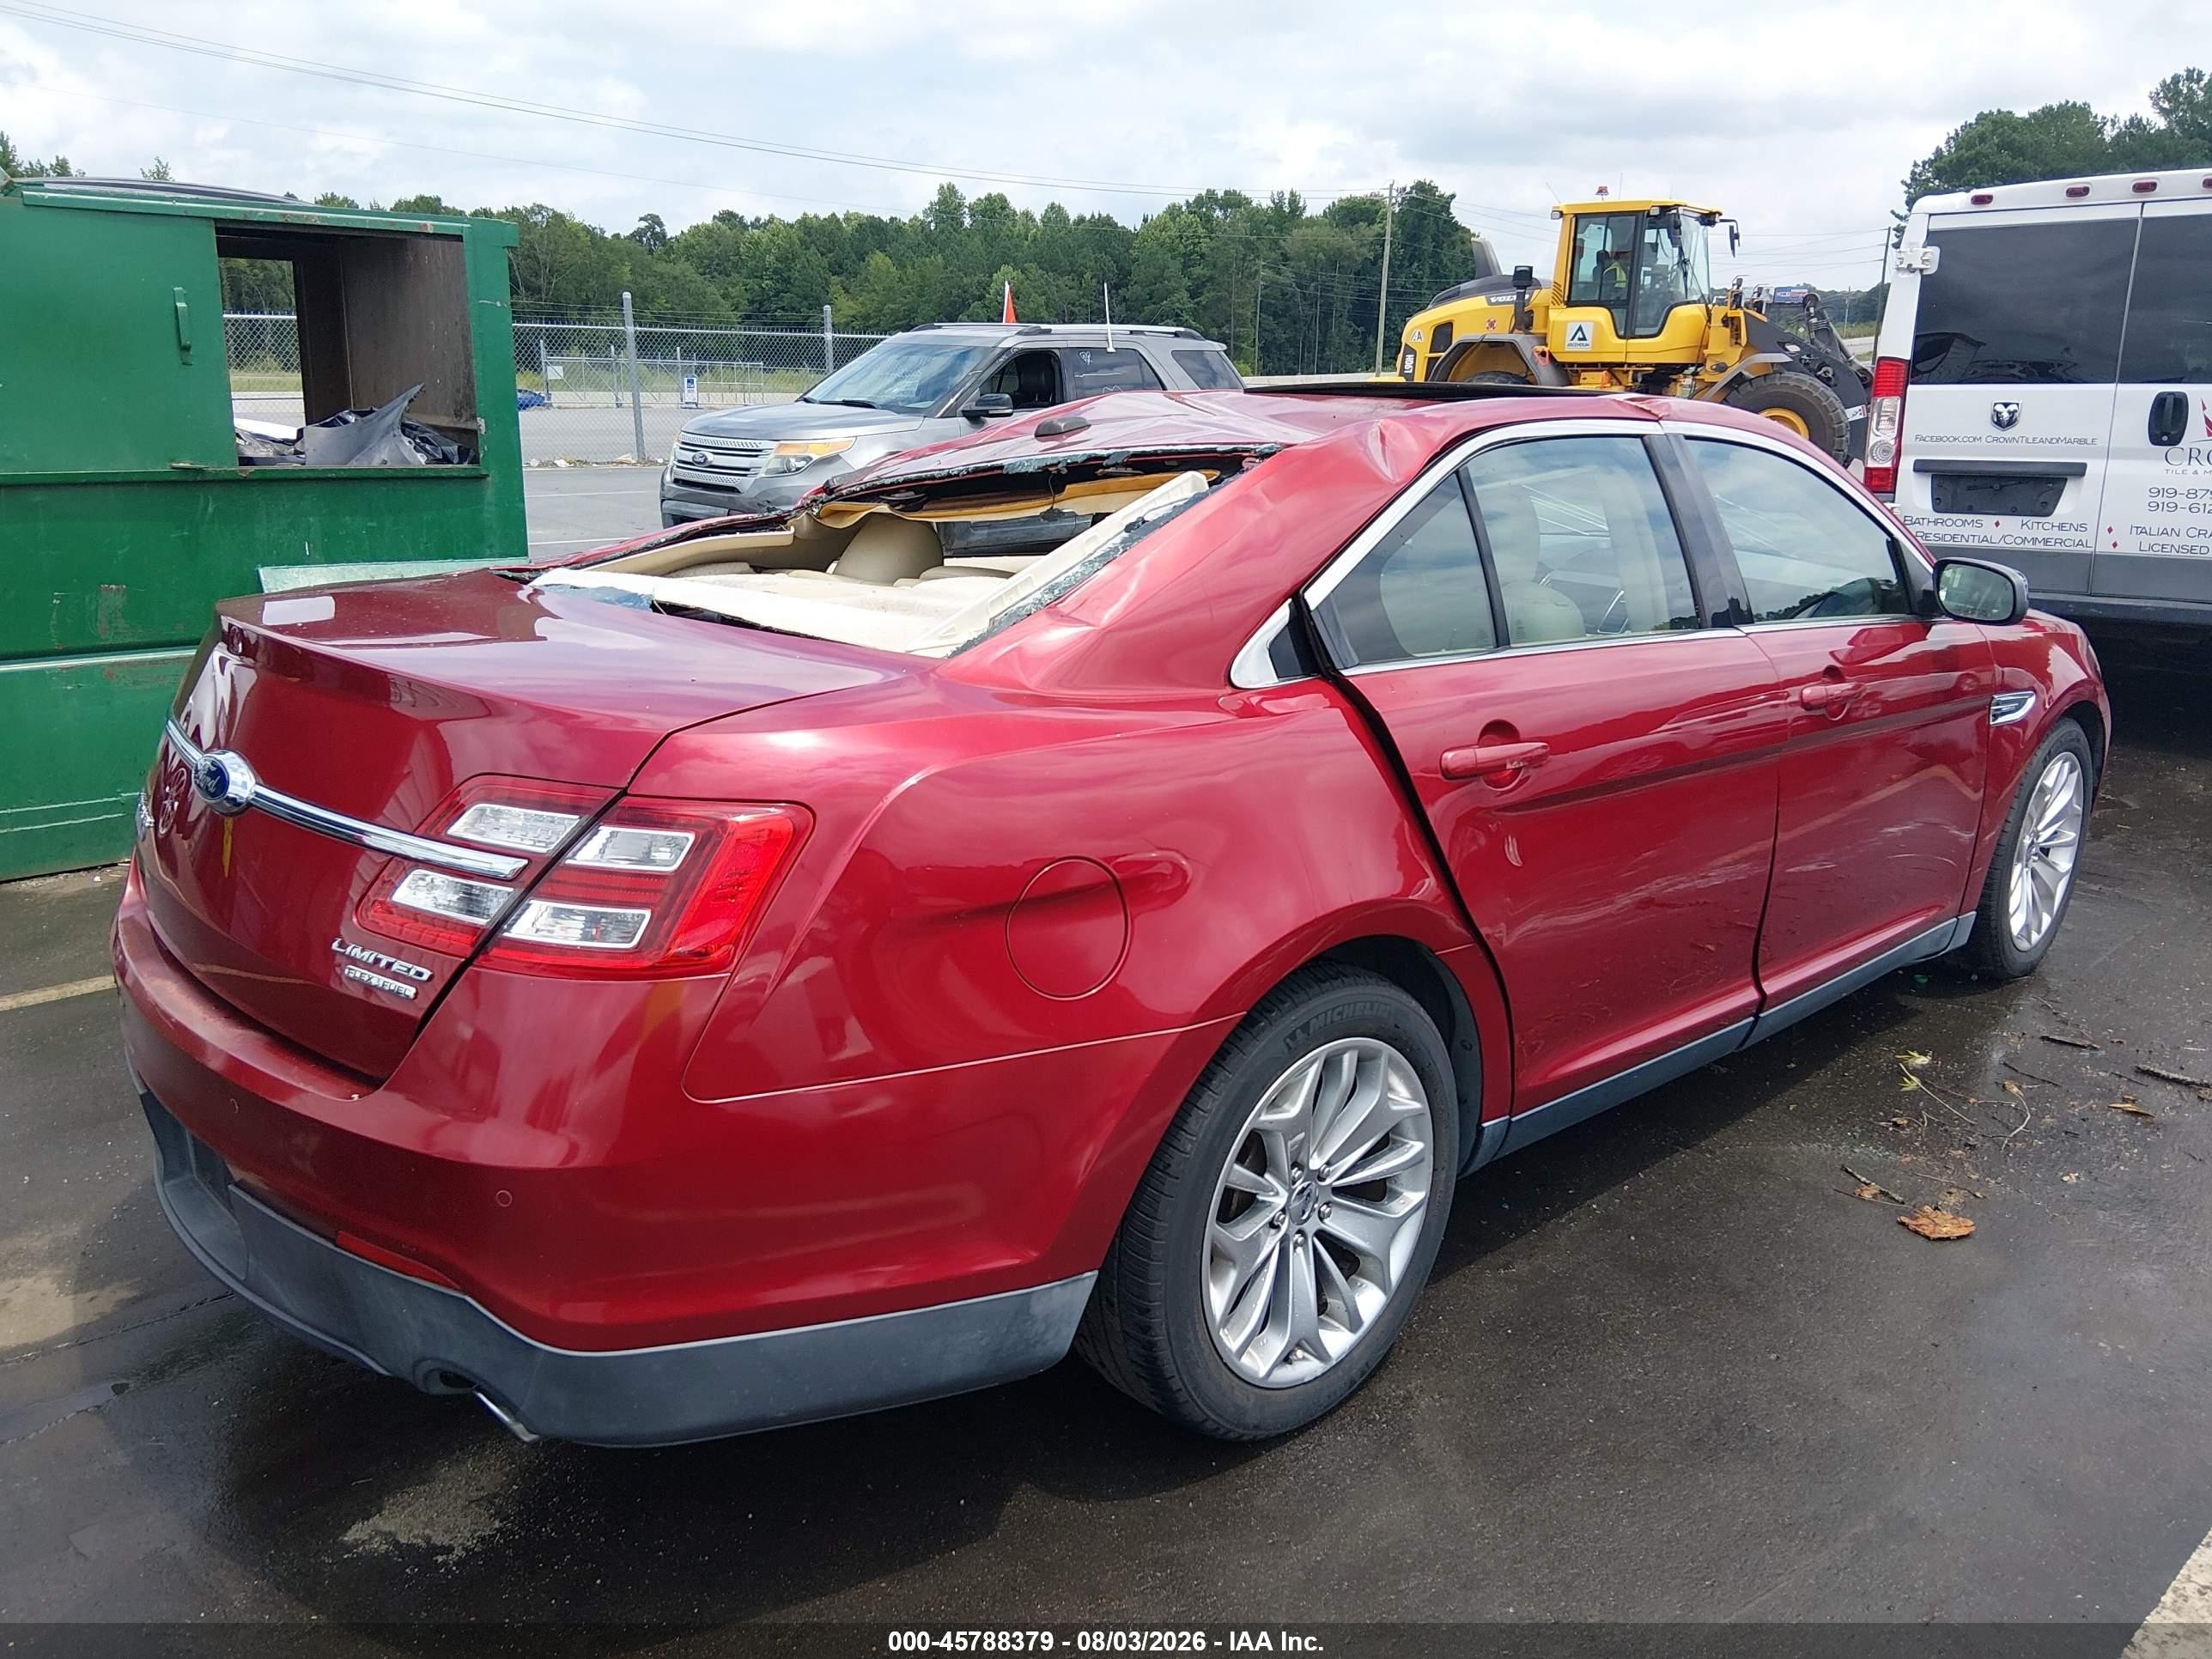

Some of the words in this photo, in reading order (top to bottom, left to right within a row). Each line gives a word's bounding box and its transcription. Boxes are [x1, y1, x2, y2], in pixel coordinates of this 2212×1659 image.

[2165, 447, 2212, 466] CR
[2148, 487, 2212, 500] 919-87
[1903, 515, 1984, 528] BATHROOMS
[2021, 520, 2088, 532] KITCHENS
[2130, 525, 2181, 538] ITALIAN
[1915, 531, 2094, 549] RESIDENTIAL/COMMERCIAL
[2139, 542, 2210, 556] LICENSED
[331, 937, 433, 981] LIMITED
[1309, 1002, 1392, 1034] MICHELIN
